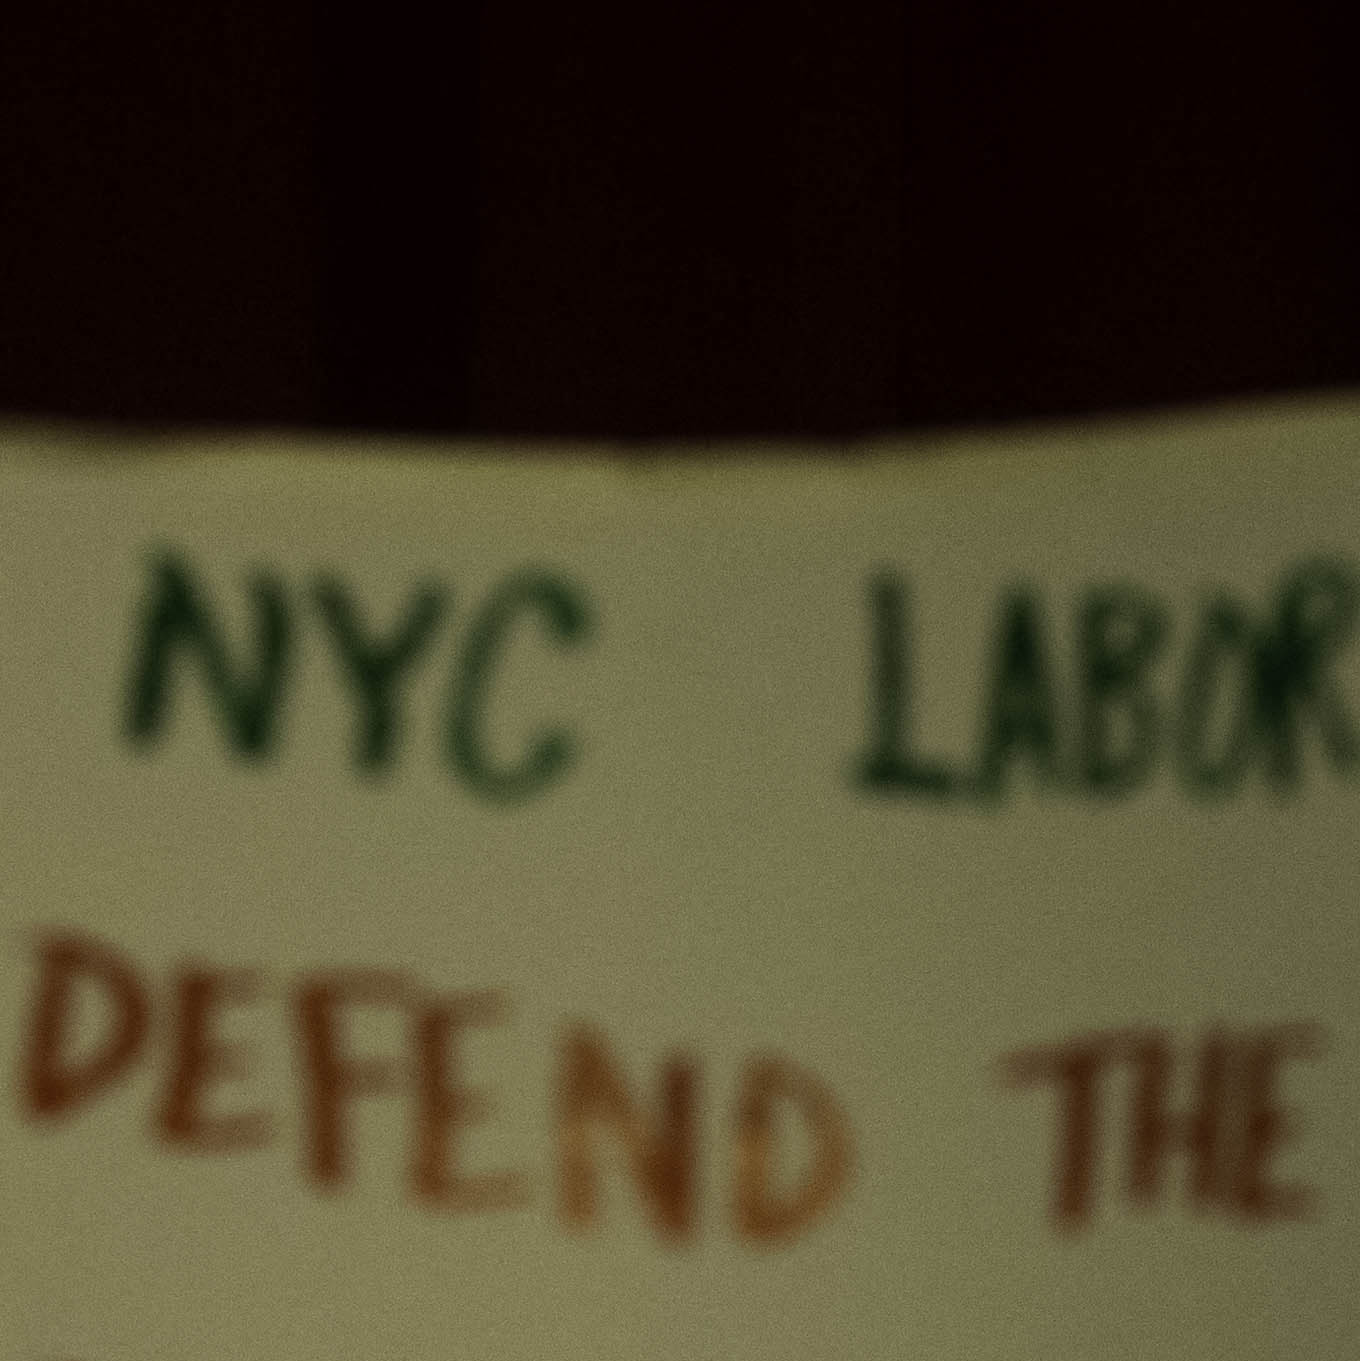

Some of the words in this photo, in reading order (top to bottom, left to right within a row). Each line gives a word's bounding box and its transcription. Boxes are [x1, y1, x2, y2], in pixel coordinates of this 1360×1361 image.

[120, 542, 598, 808] NYC
[22, 922, 855, 1248] DEFEND
[990, 1015, 1326, 1243] THE
